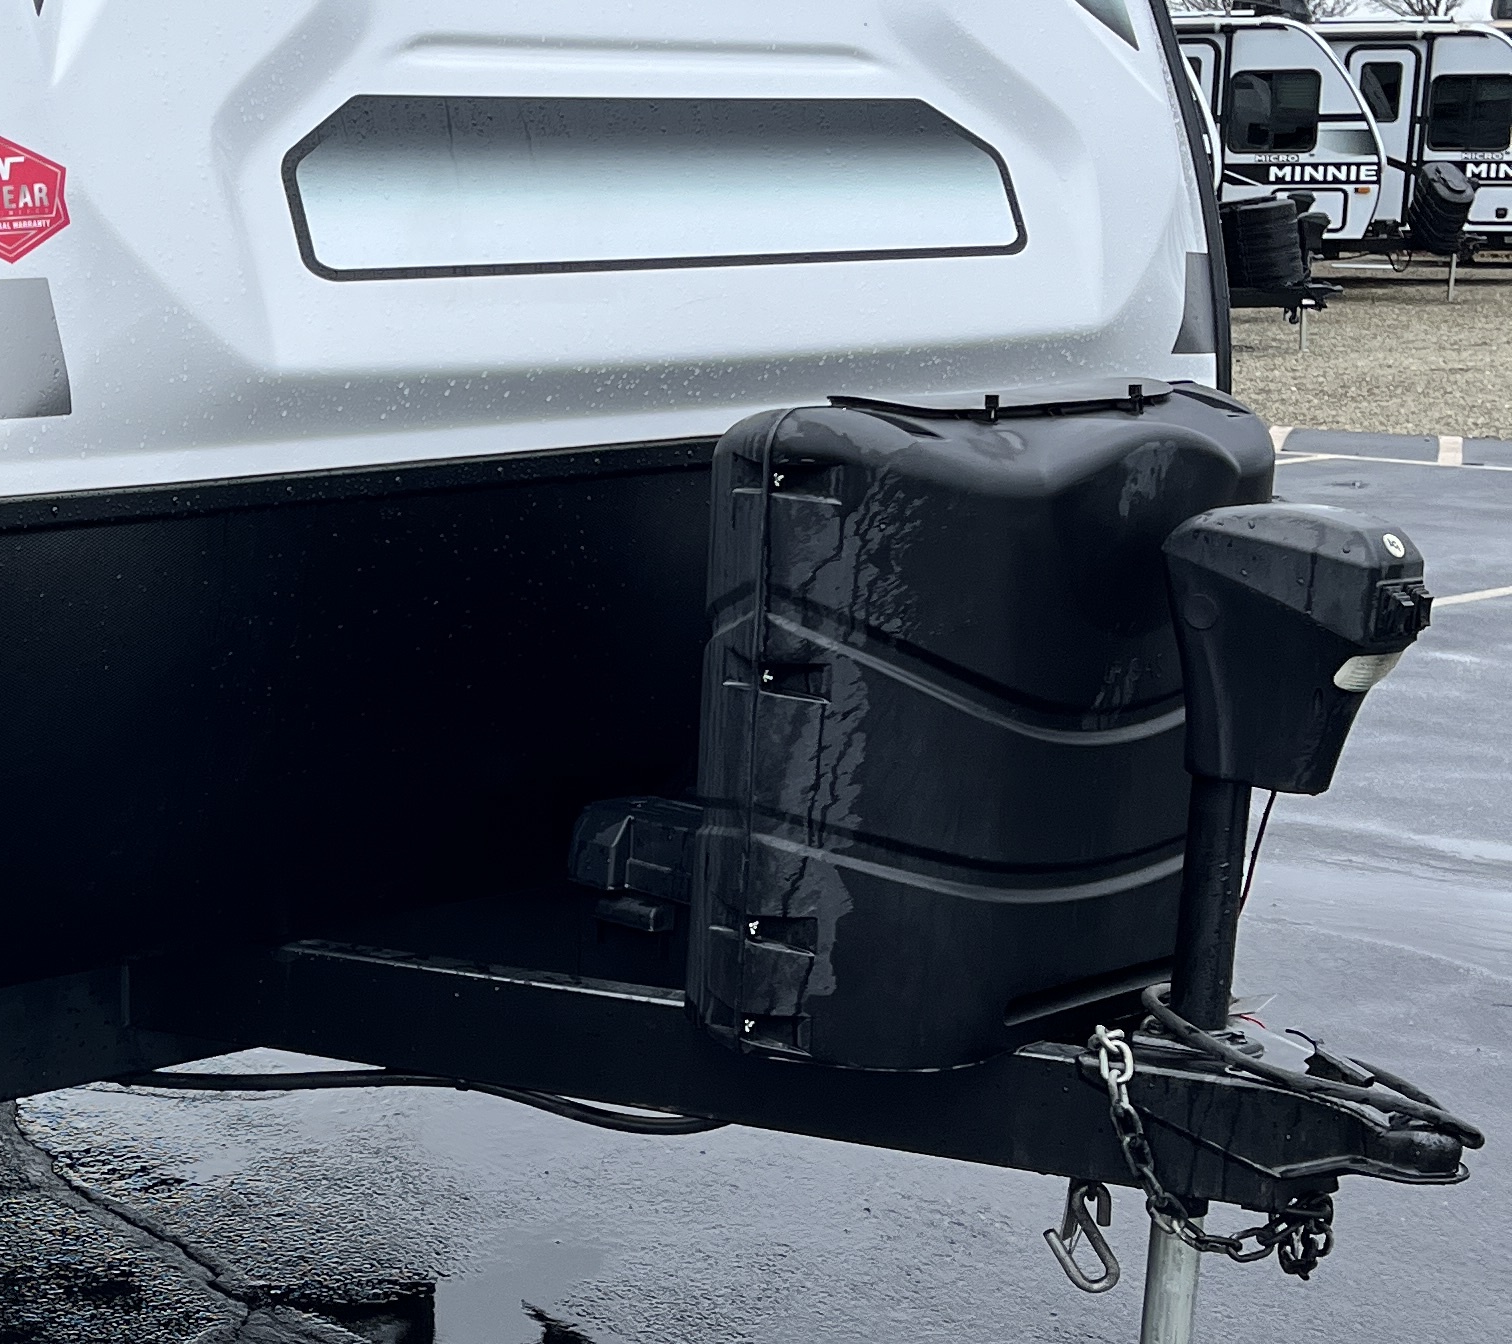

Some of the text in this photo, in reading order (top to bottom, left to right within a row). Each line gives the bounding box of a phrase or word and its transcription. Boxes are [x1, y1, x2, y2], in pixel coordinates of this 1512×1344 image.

[1255, 154, 1299, 163] MICRO
[1461, 152, 1504, 161] MICRO
[1268, 165, 1378, 182] MINNIE
[12, 219, 51, 230] WARRANTY
